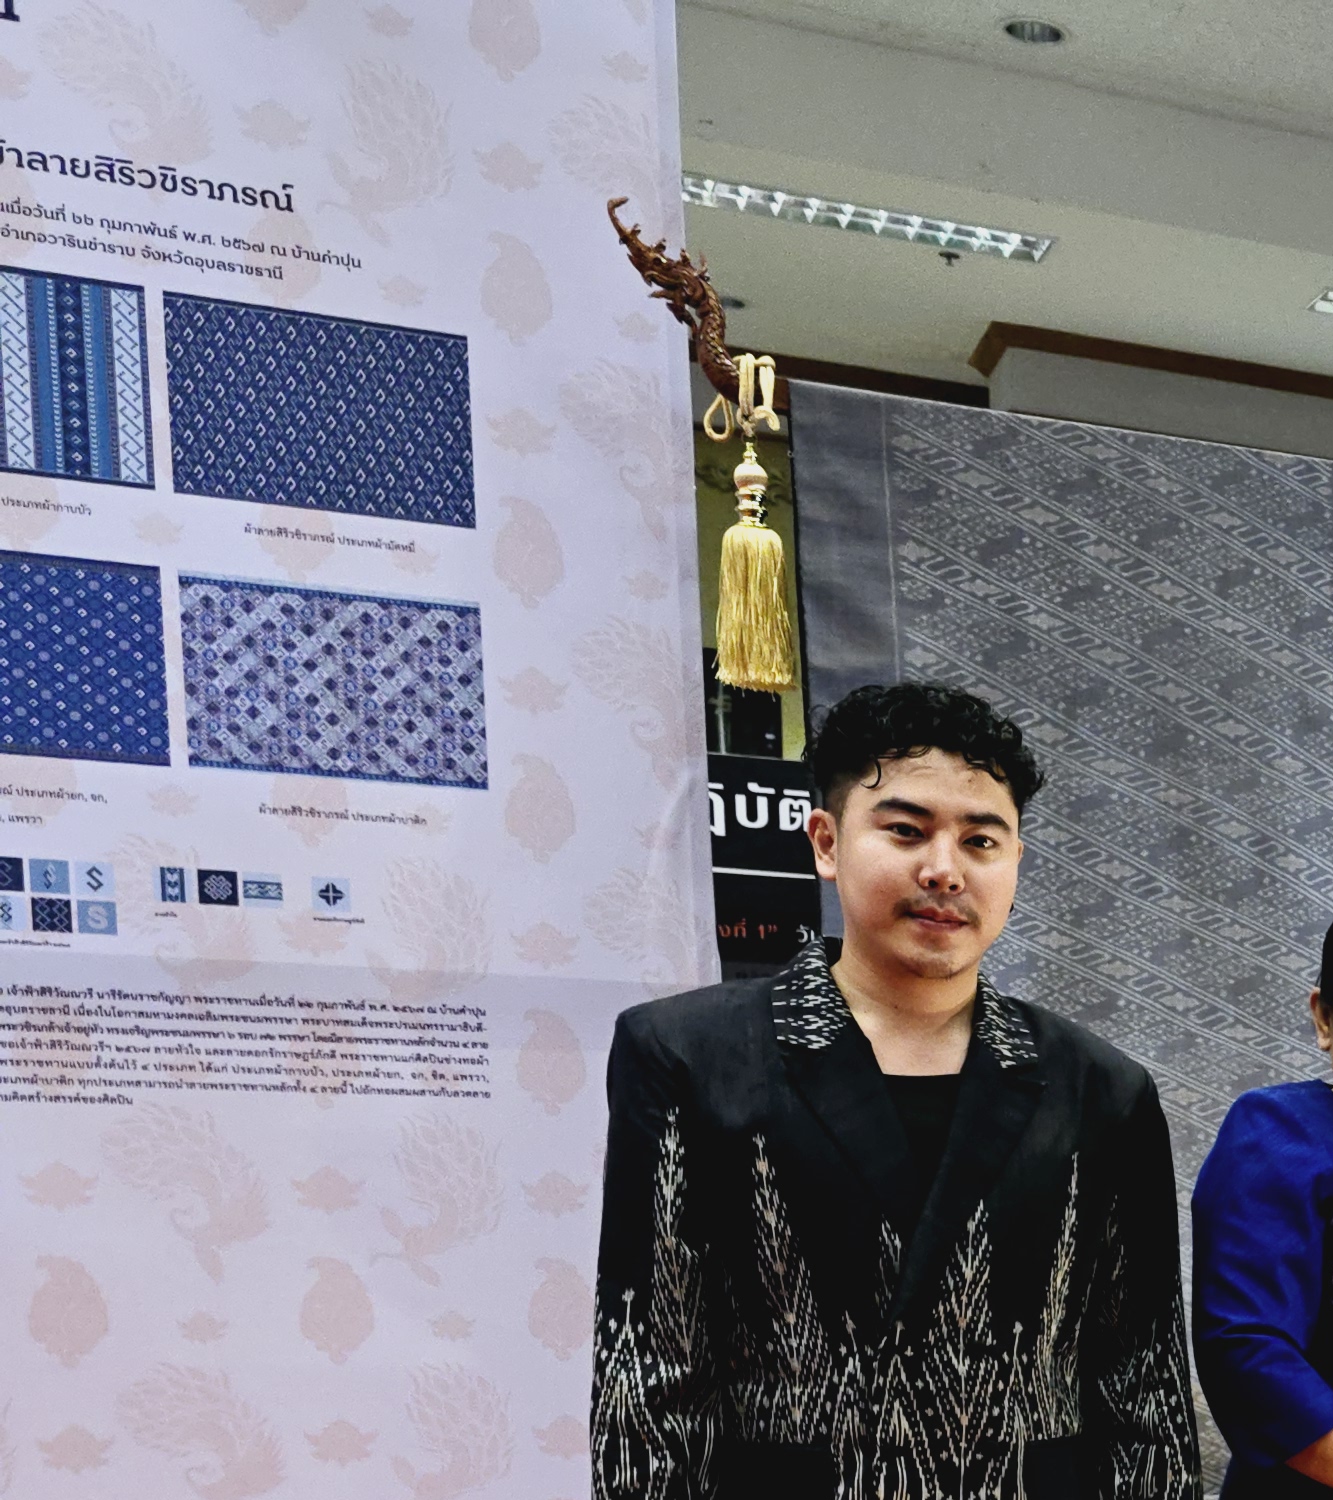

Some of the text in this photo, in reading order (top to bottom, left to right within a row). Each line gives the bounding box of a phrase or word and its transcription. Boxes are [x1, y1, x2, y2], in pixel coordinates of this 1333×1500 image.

[0, 223, 284, 281] อำเภอวารินชำราบ จังหวัดอุบลราชธานี
[72, 213, 94, 226] ๒๒
[100, 216, 178, 240] กุมภาพันธ์
[182, 229, 216, 247] พ.ศ.
[270, 244, 287, 257] ณ
[291, 244, 362, 273] บ้านคำปุน
